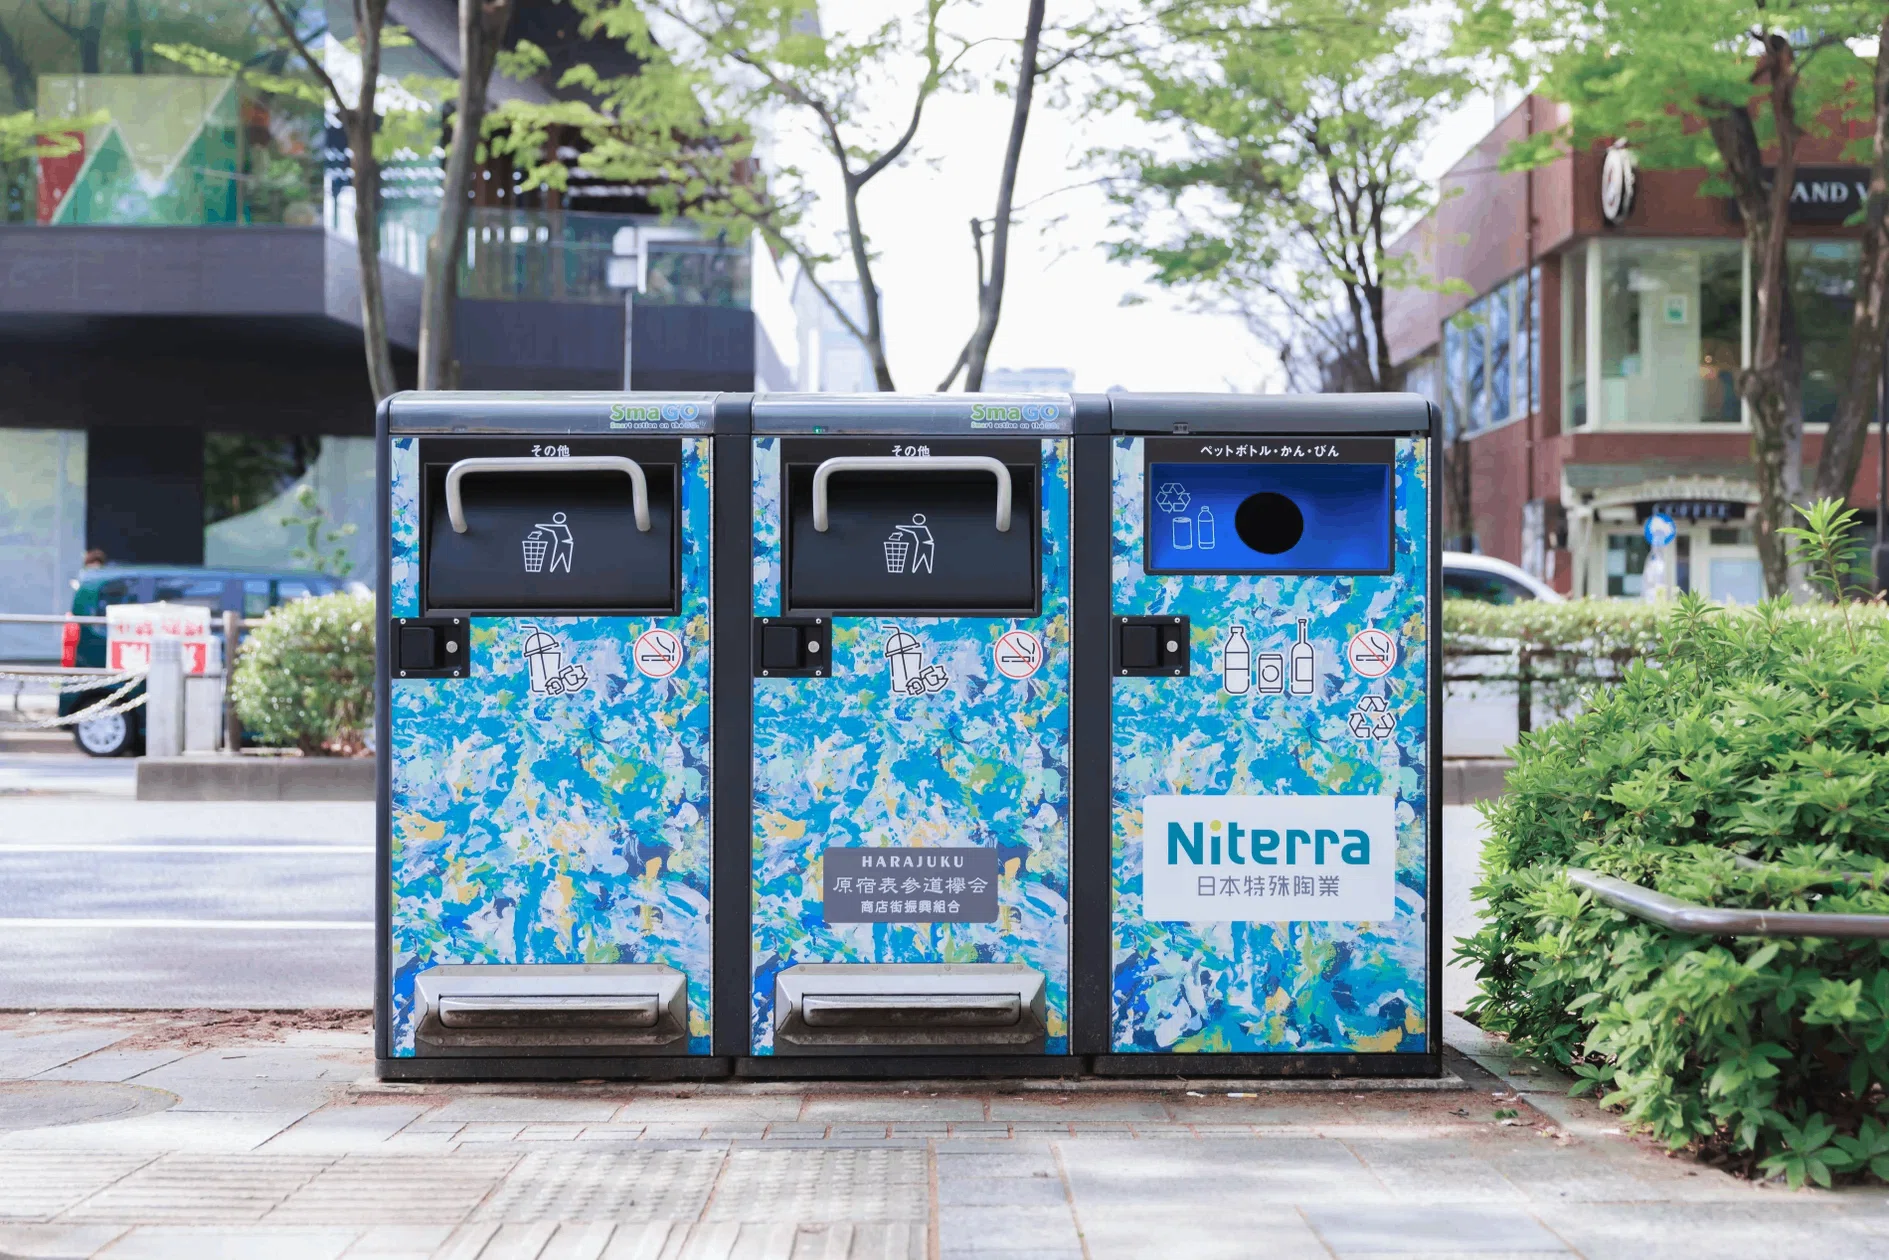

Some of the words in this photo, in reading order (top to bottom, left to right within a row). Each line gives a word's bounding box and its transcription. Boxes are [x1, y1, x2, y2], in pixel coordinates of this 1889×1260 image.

[610, 403, 699, 421] SmaGO
[971, 403, 1059, 421] SmaGO
[531, 444, 570, 457] その他
[891, 444, 931, 457] その他
[1167, 820, 1371, 865] Niterra
[862, 855, 964, 868] HARAJUKU
[1198, 875, 1340, 897] 日本特殊陶業
[860, 899, 961, 914] 商店街振興組合
